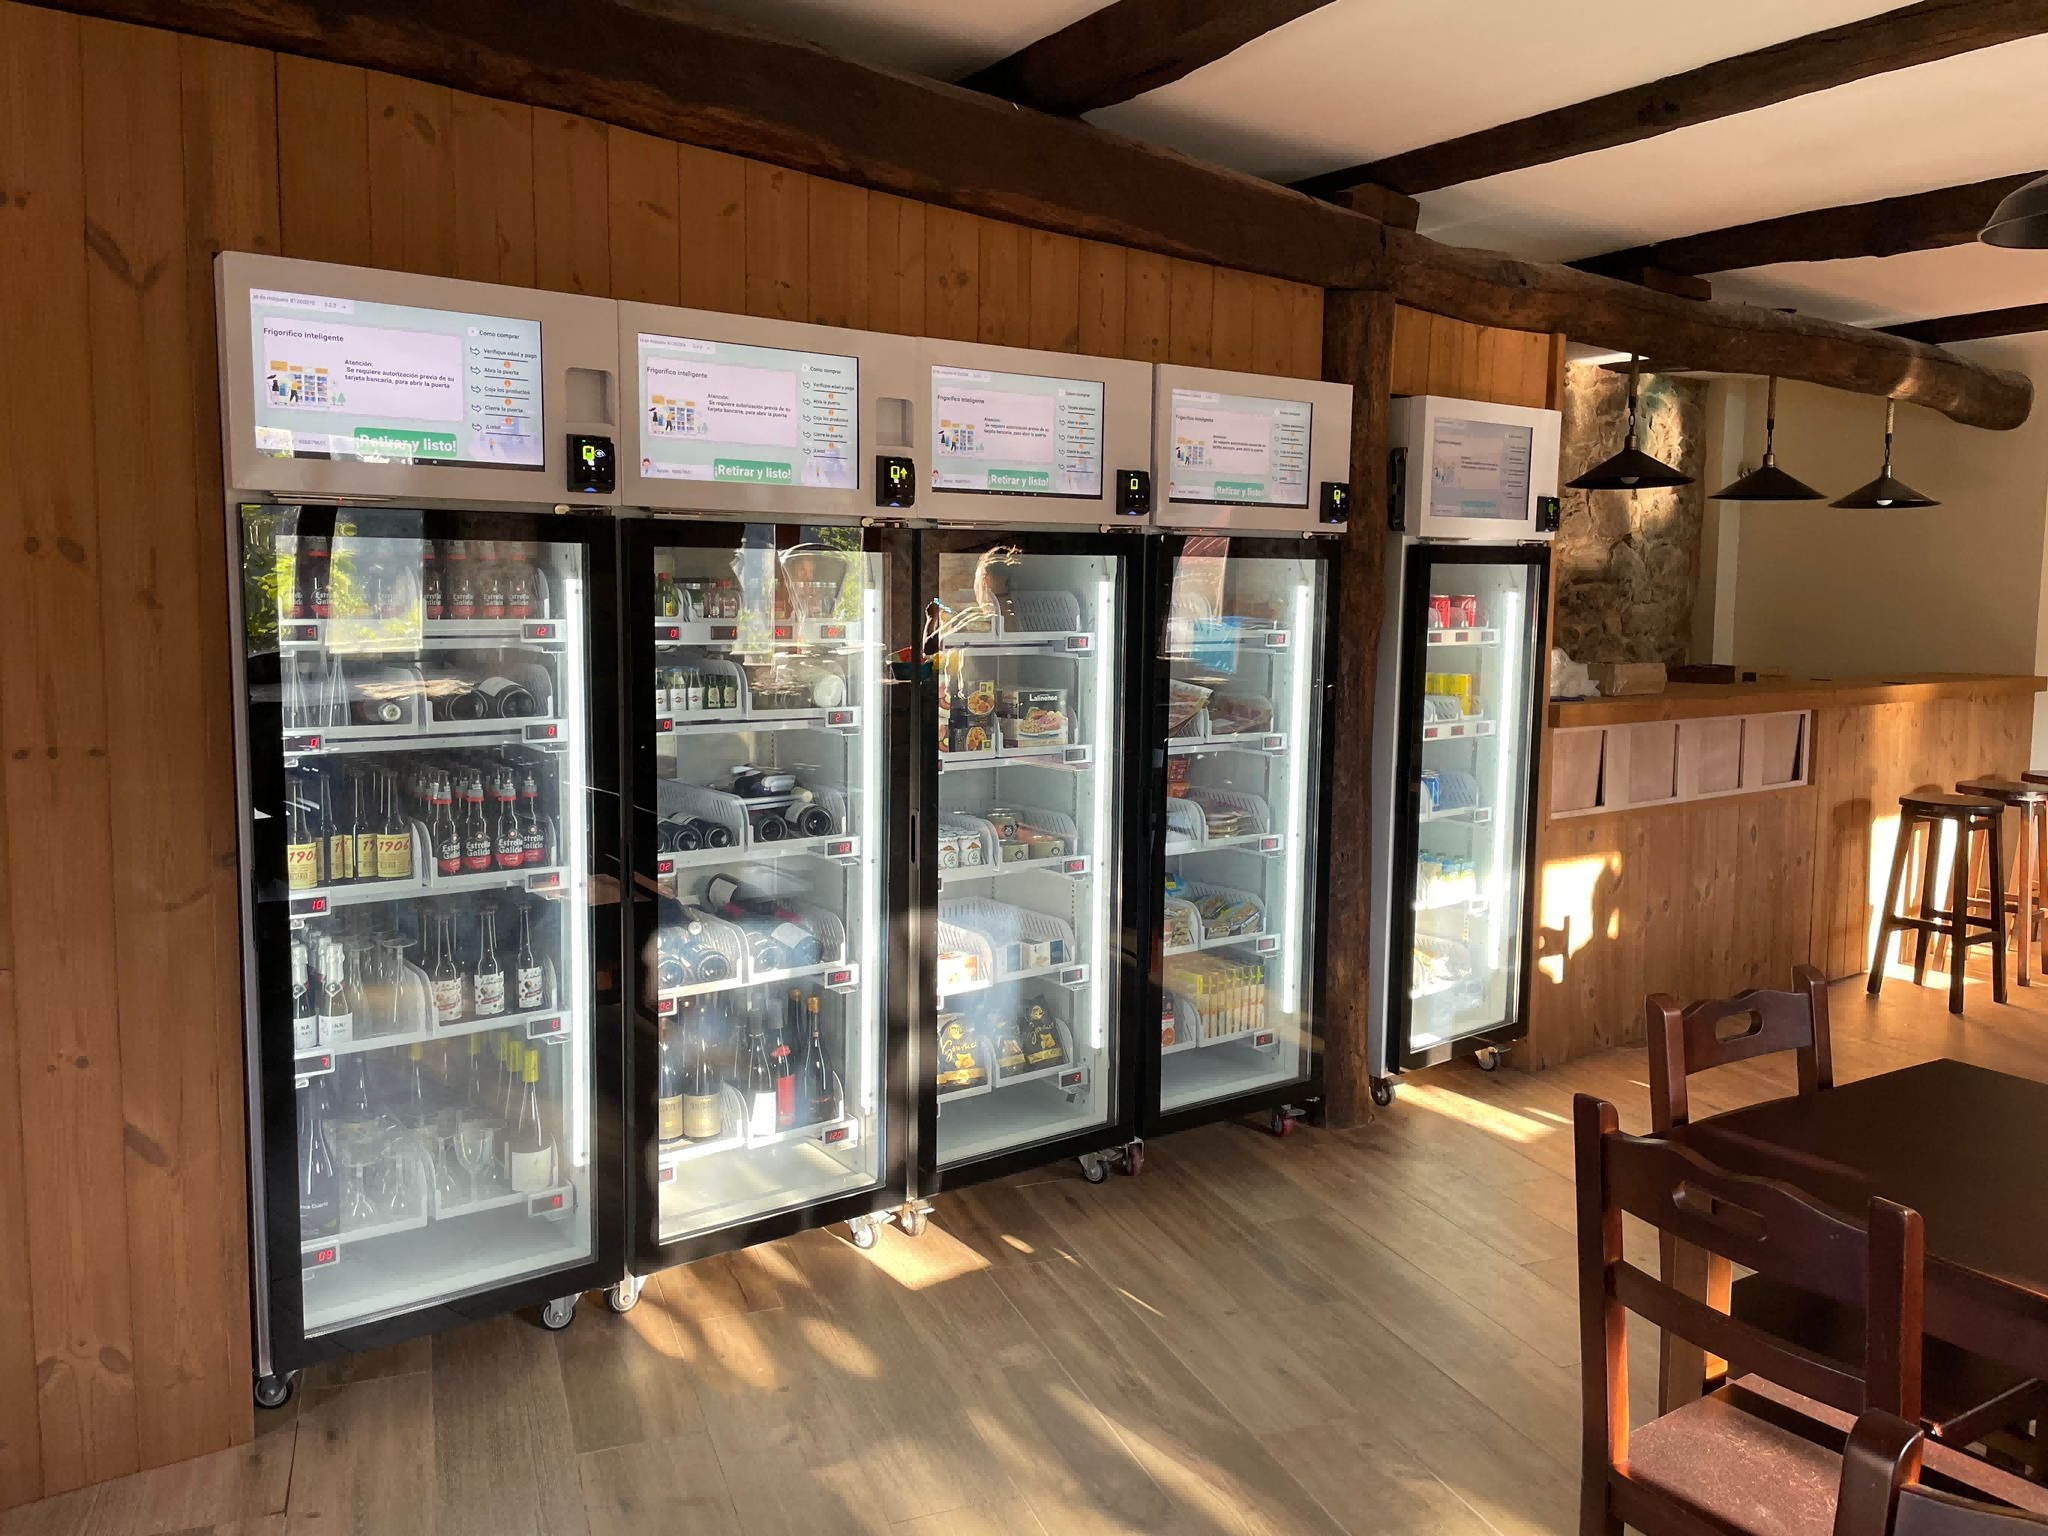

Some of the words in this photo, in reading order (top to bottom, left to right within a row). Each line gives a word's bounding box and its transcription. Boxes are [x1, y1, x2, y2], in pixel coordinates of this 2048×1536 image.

[304, 331, 344, 342] inteligente
[344, 374, 365, 382] tarjeta
[409, 379, 424, 387] abrir
[382, 370, 419, 379] autorización
[419, 374, 438, 382] previa
[423, 437, 457, 453] listo!
[714, 464, 754, 478] ¡Retirar
[757, 469, 763, 480] y
[765, 469, 792, 479] listo!
[379, 840, 409, 853] 1906
[312, 899, 324, 910] 10
